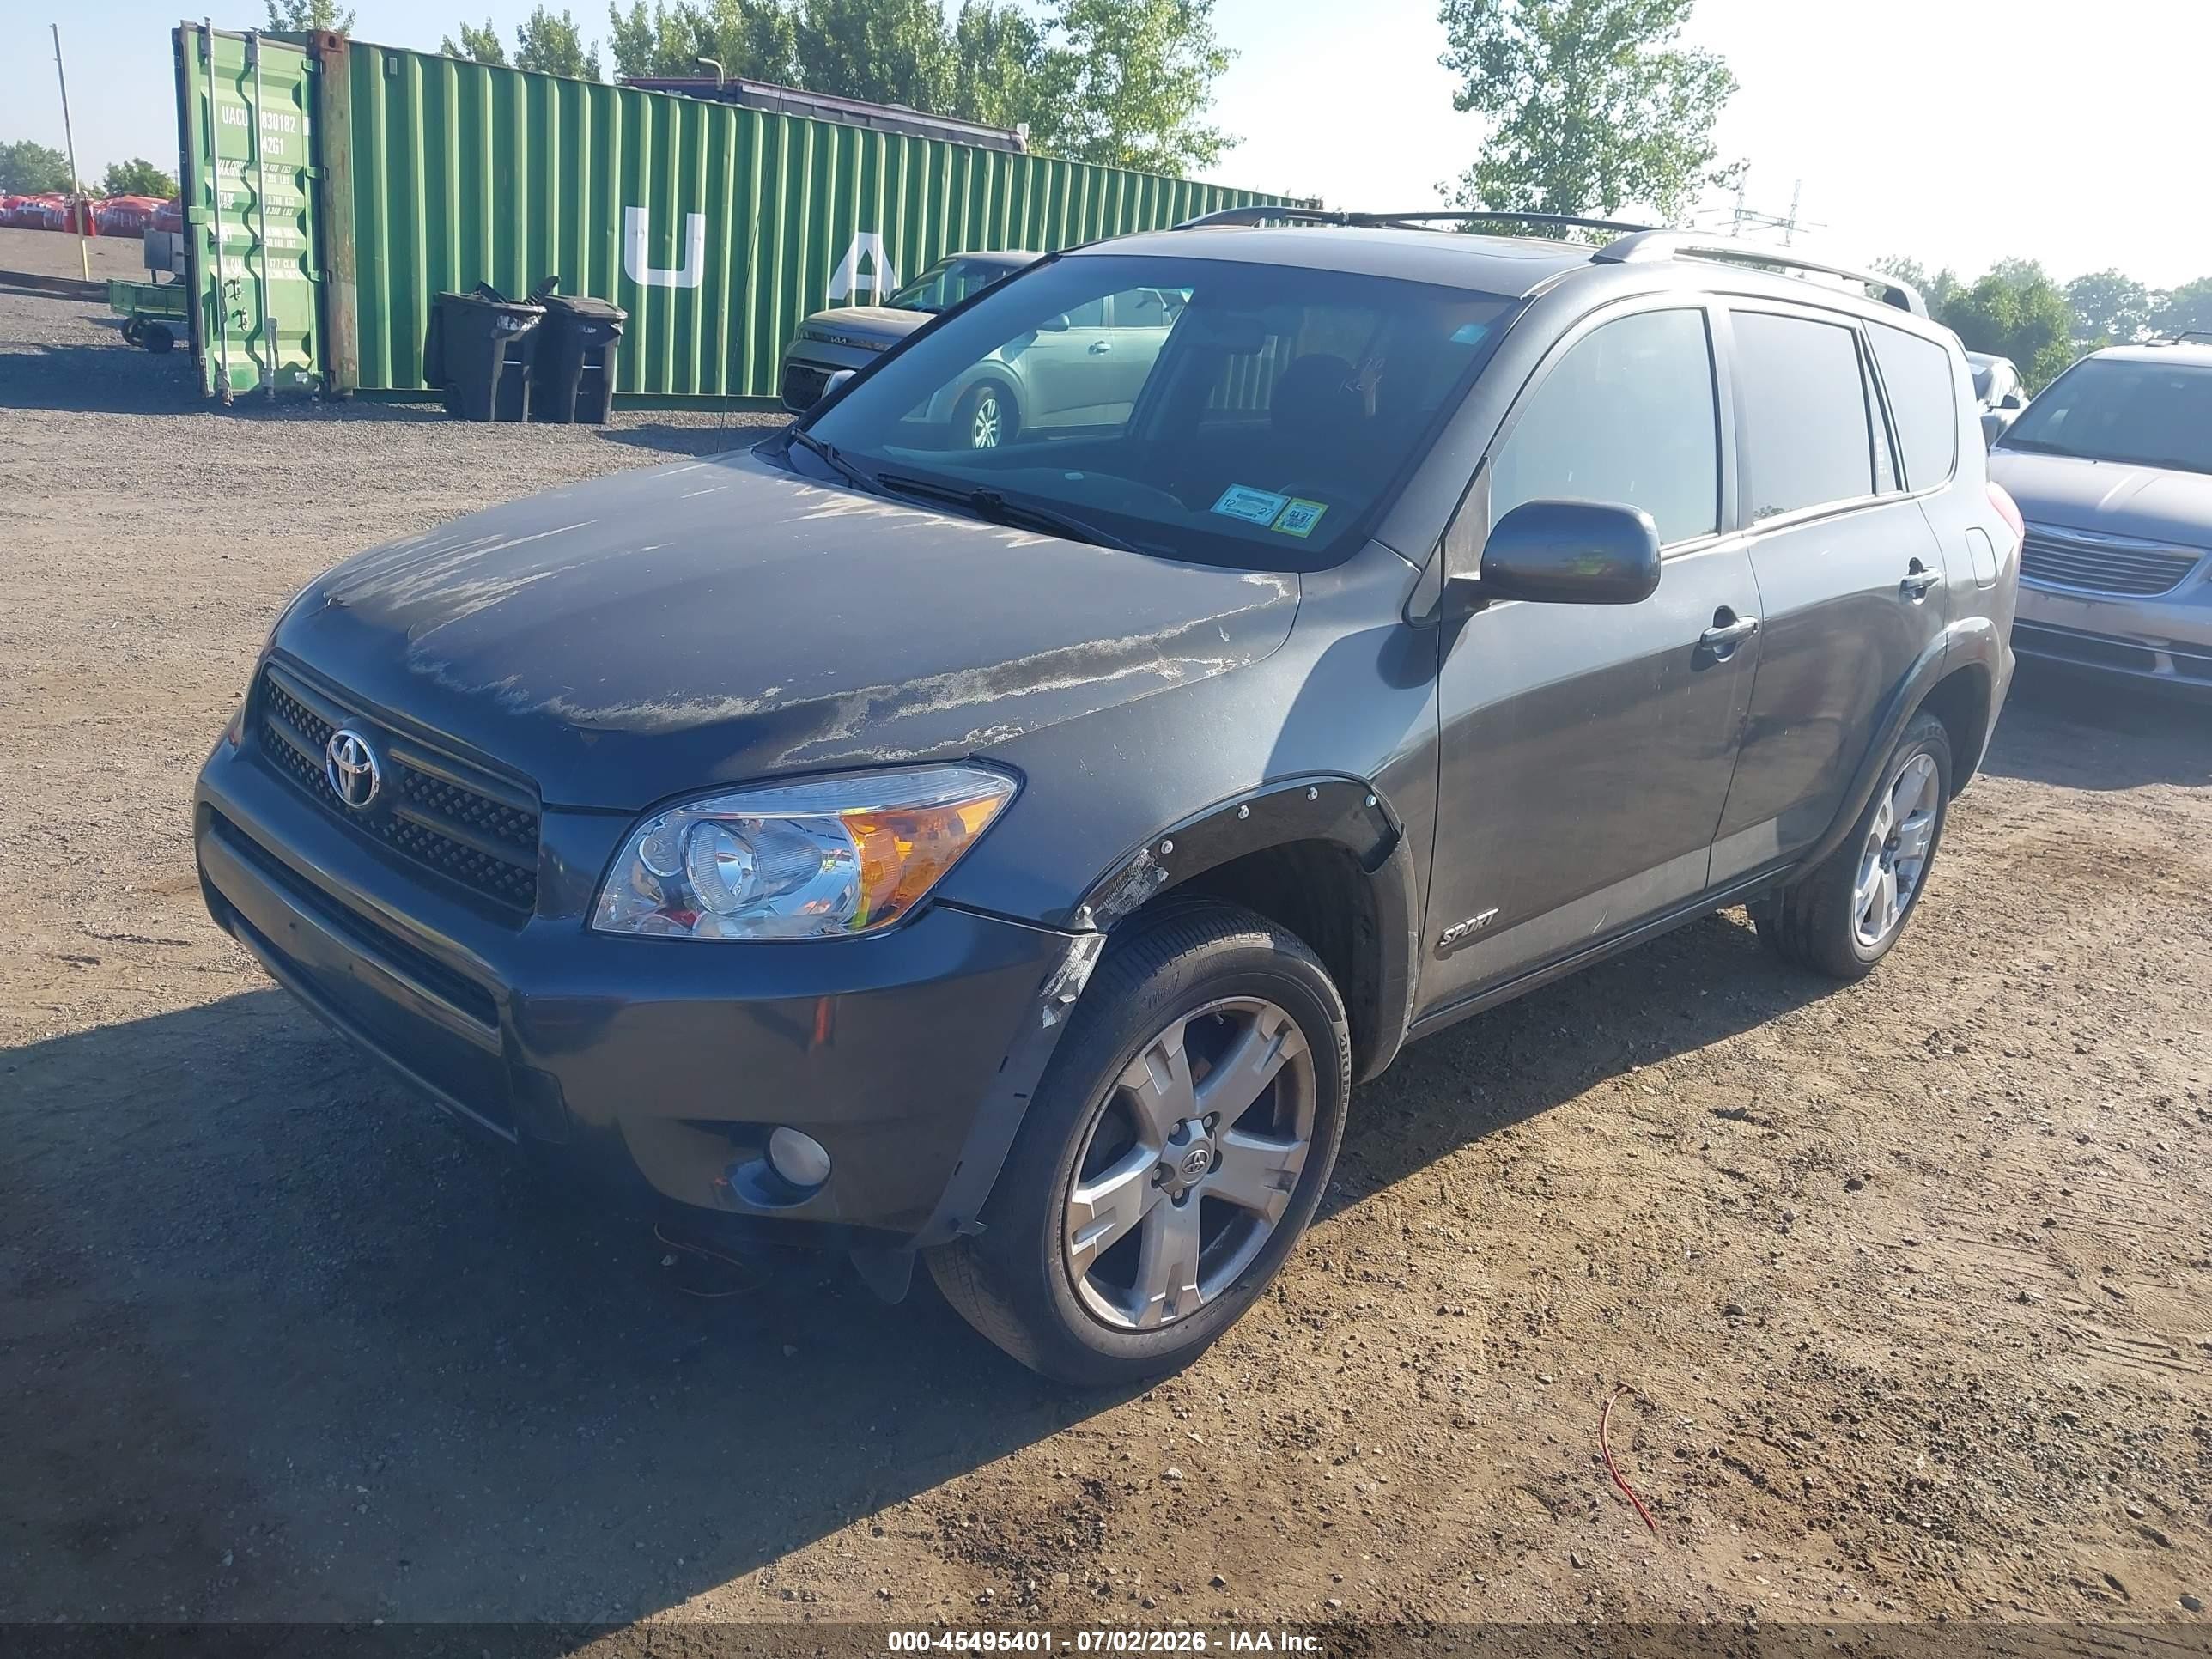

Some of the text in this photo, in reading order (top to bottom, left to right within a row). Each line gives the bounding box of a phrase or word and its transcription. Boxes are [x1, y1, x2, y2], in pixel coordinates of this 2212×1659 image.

[222, 106, 248, 127] UACU
[261, 111, 296, 133] 830182
[624, 206, 899, 301] U A
[1223, 499, 1237, 507] 12
[1257, 507, 1275, 517] 27
[1439, 908, 1499, 947] SPORT
